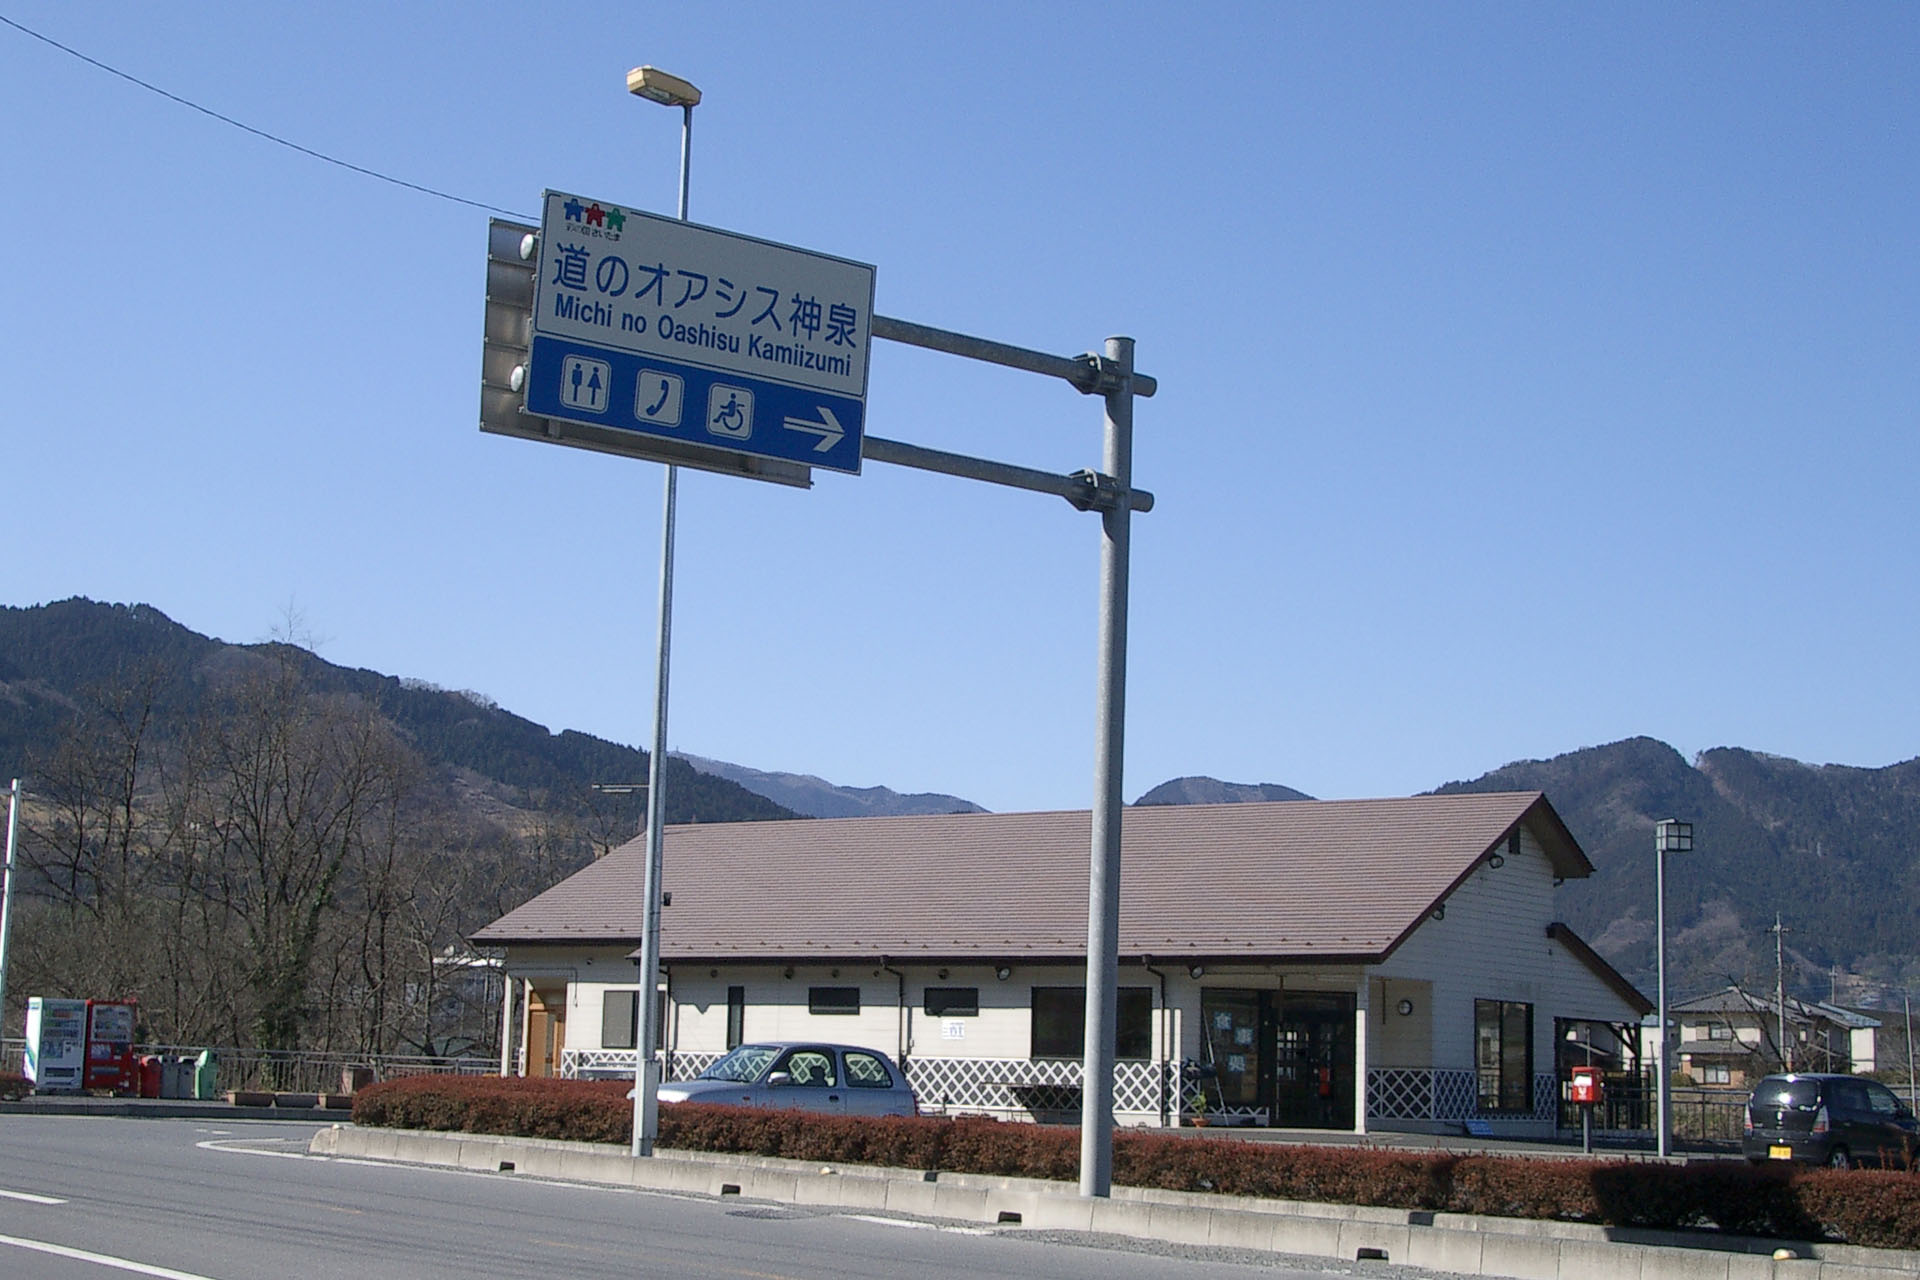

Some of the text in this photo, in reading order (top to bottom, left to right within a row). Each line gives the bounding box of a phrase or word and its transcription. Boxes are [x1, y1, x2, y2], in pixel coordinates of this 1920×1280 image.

[552, 242, 856, 348] 道のオアシス神泉
[555, 293, 851, 376] Michi no Oashisu Kamiizumi
